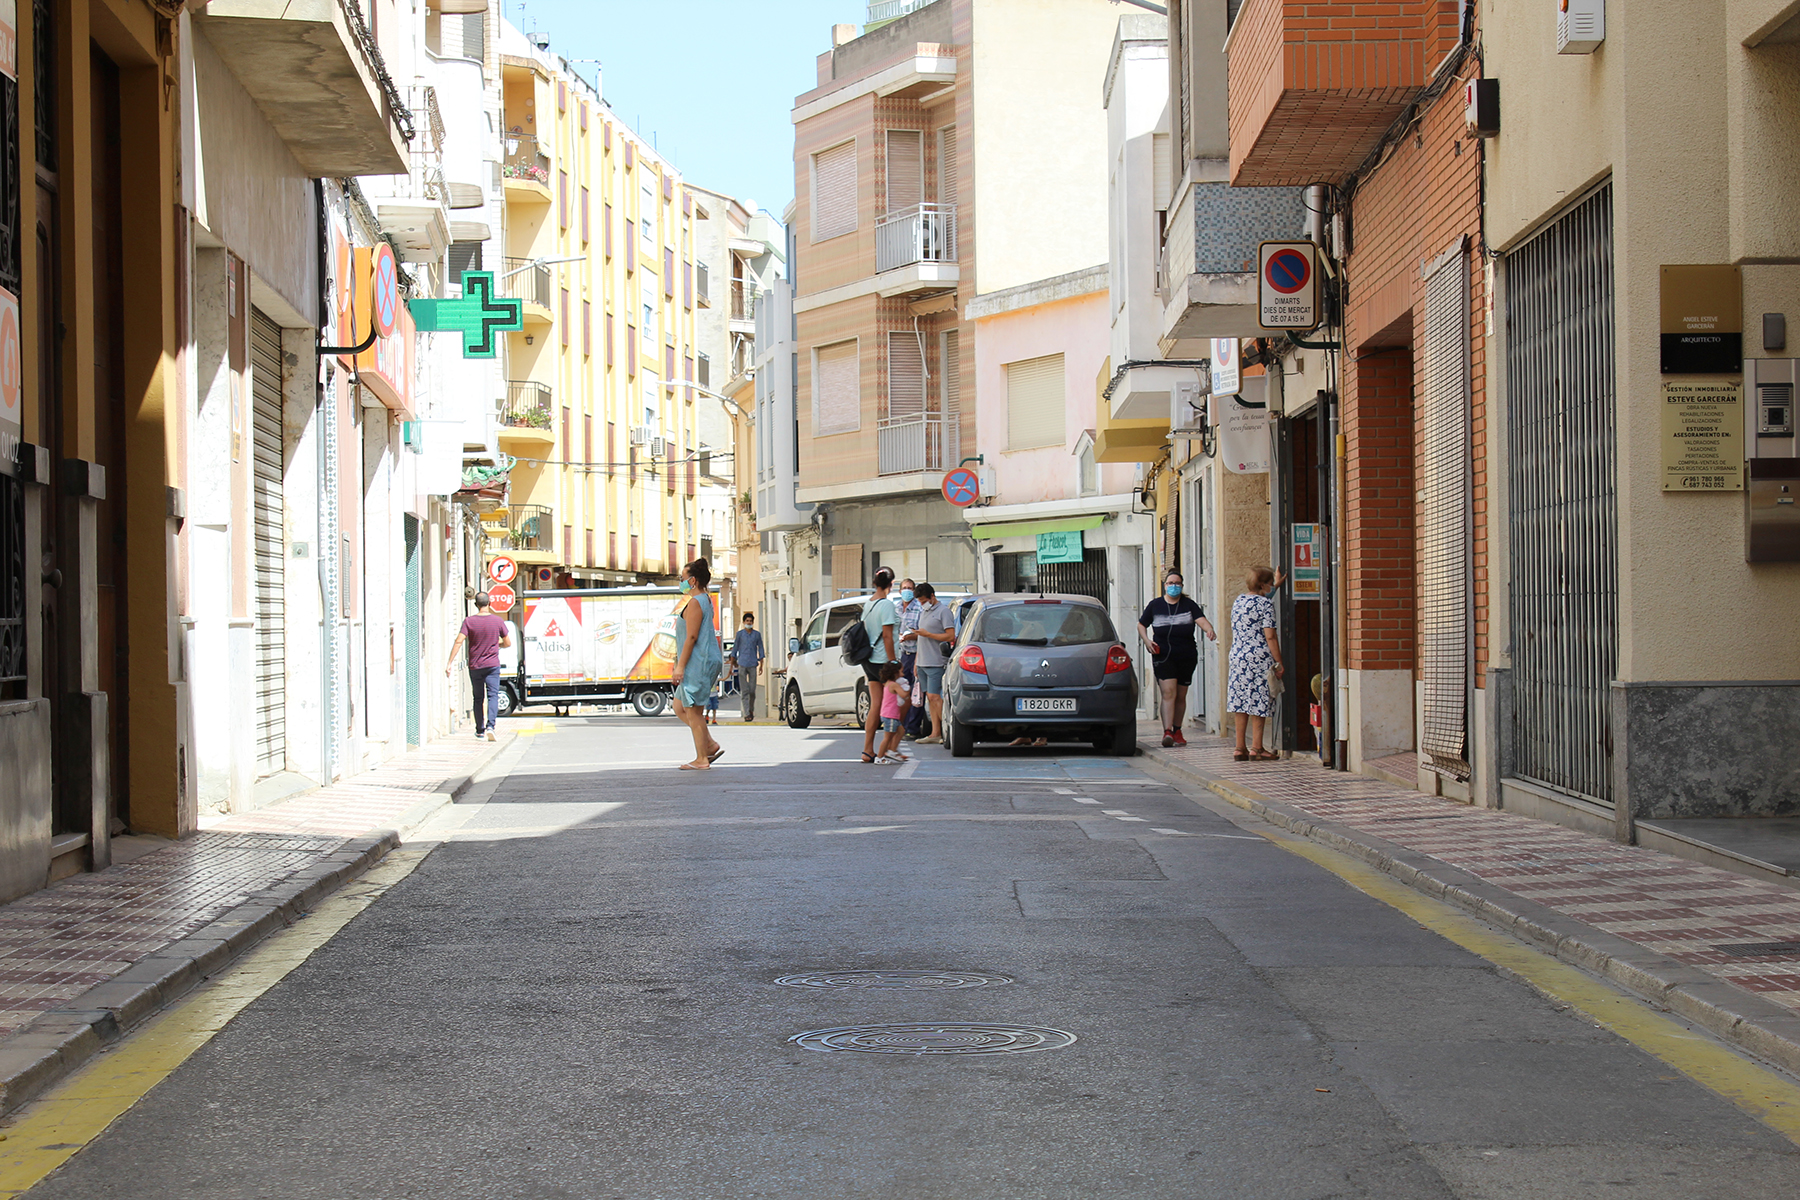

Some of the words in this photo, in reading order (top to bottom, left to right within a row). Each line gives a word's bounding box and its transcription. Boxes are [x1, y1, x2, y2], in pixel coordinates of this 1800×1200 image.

[1697, 394, 1737, 402] GARCERÁN
[536, 641, 571, 652] Aldisa
[1024, 700, 1049, 709] 1820
[1053, 700, 1072, 709] GKR
